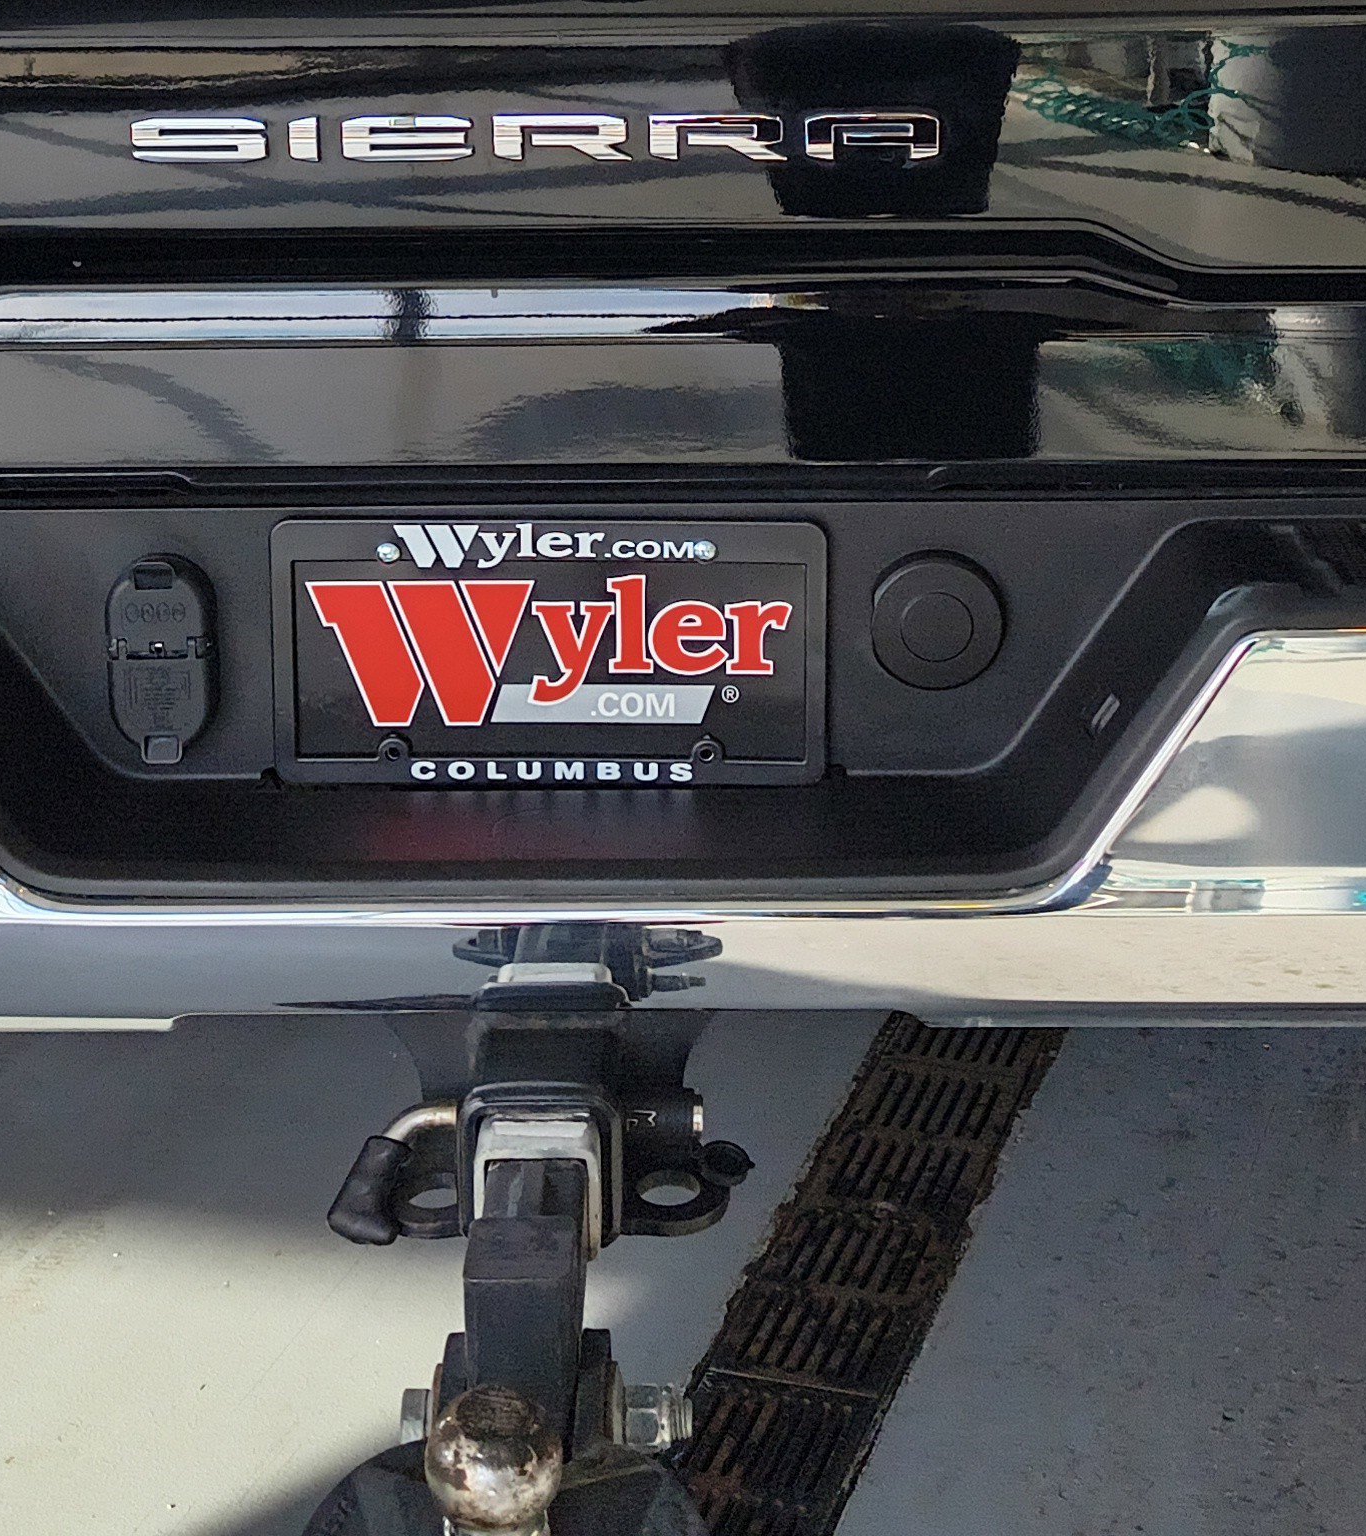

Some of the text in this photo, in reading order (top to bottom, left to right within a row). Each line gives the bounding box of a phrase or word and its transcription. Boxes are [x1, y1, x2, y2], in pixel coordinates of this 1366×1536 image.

[130, 114, 941, 162] SIERRA
[304, 573, 793, 727] Wyler
[410, 761, 694, 783] COLUMBUS
